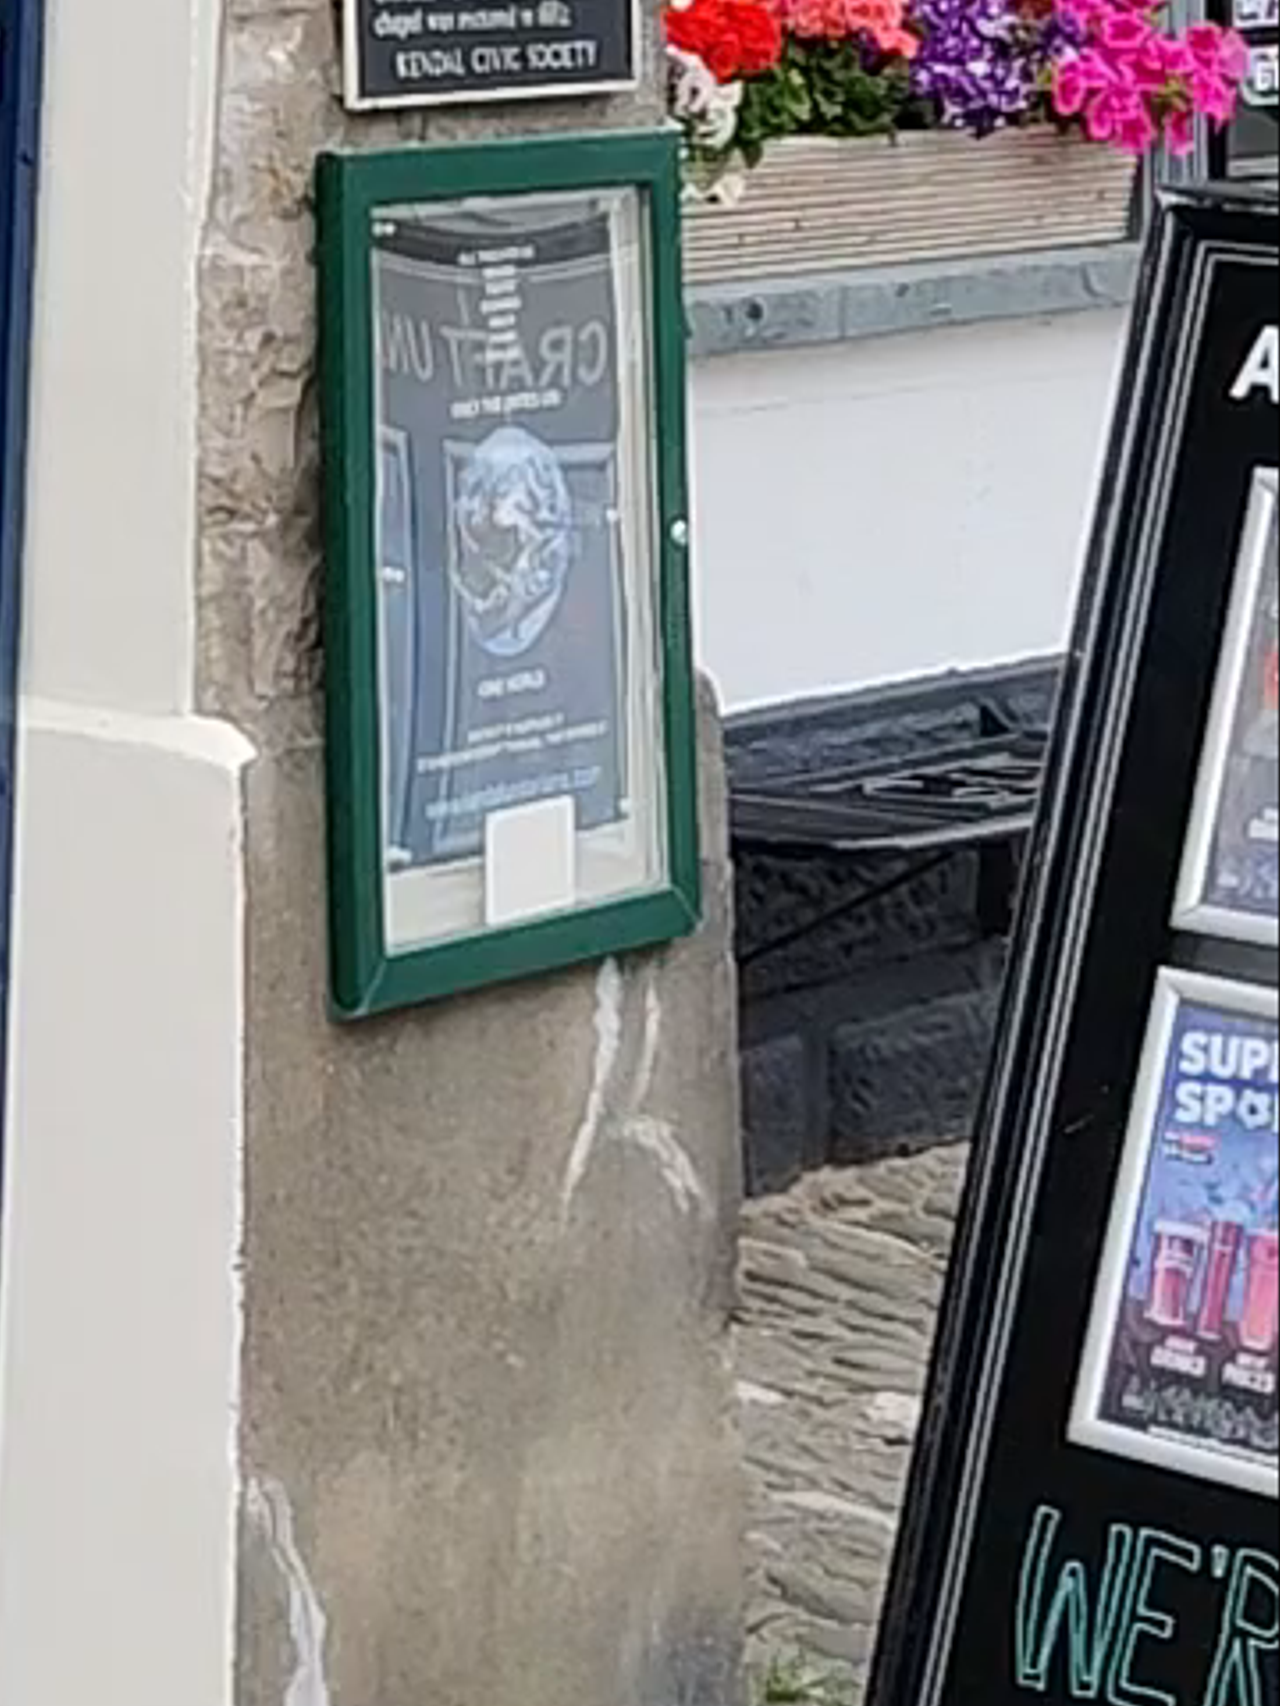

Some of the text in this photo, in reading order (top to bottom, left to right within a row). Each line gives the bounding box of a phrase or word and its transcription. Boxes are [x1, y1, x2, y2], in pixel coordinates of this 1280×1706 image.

[396, 40, 598, 79] KENDAL CIVIC SOCIETY
